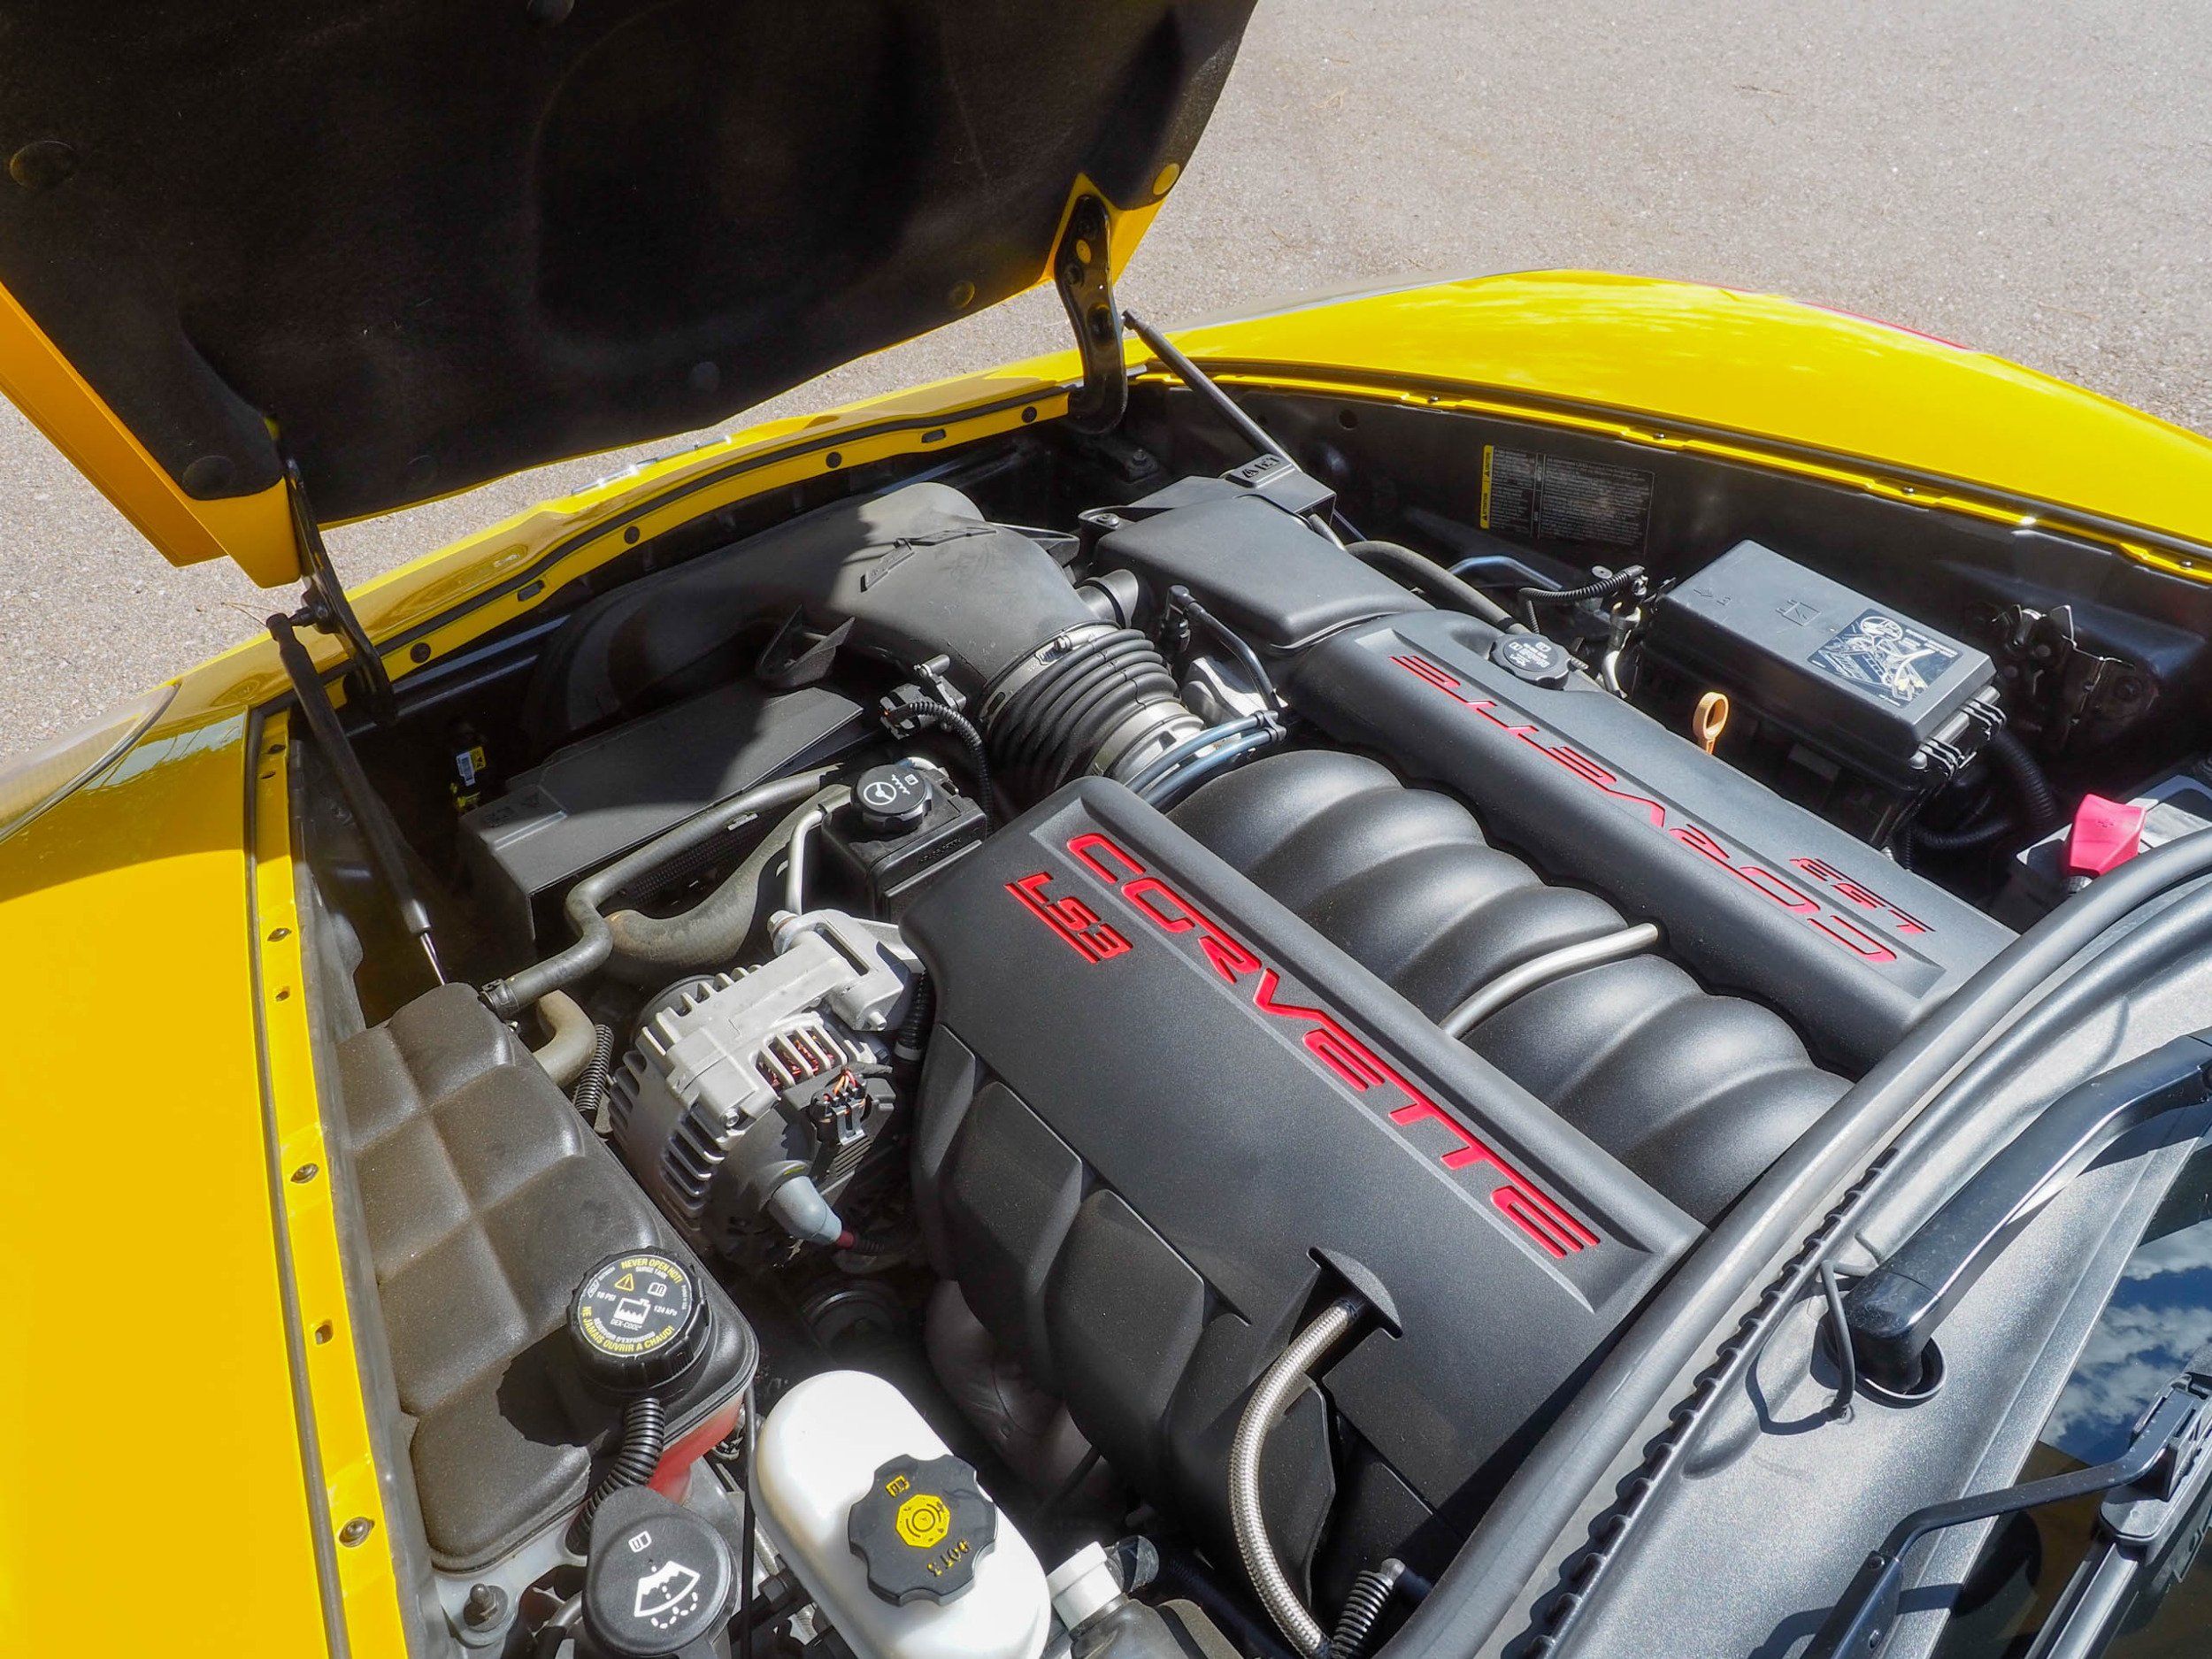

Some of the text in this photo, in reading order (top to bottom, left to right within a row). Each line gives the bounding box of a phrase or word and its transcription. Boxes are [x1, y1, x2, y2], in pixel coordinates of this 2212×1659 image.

[1387, 655, 1898, 963] CORVETTE
[1789, 856, 1936, 934] LS3
[1005, 872, 1133, 965] LS3
[1066, 832, 1601, 1259] CORVETTE
[621, 1258, 684, 1284] NEVER OPEN HOT!
[582, 1306, 592, 1317] NE
[654, 1305, 664, 1314] 124
[583, 1318, 605, 1344] JAMAIS
[644, 1325, 675, 1349] CHAUD!
[603, 1340, 634, 1352] OUVRIR
